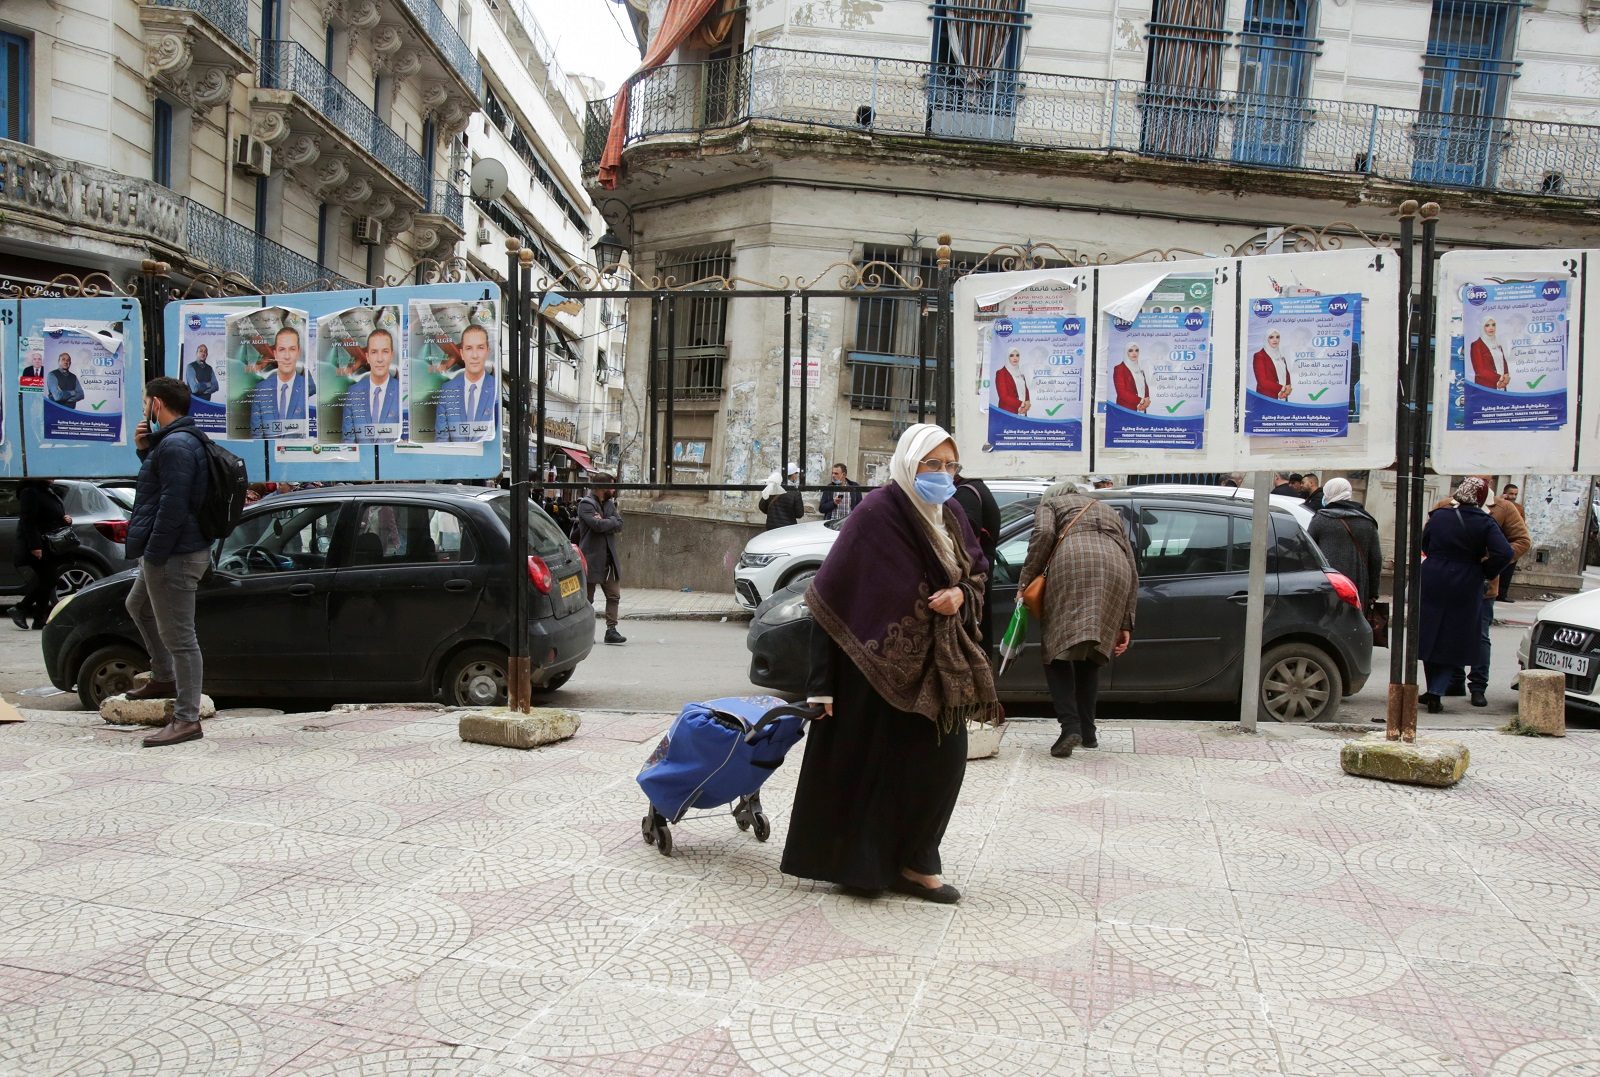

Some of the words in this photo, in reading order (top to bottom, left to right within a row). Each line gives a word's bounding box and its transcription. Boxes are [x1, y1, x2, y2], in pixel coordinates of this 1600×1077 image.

[1368, 254, 1384, 272] 4
[1528, 323, 1552, 333] 015
[1313, 337, 1338, 346] 015
[1049, 356, 1072, 365] 015
[1170, 352, 1194, 361] 015
[94, 358, 113, 367] 015
[1538, 650, 1557, 666] 27283
[1562, 656, 1572, 669] 114
[1577, 659, 1586, 673] 31
